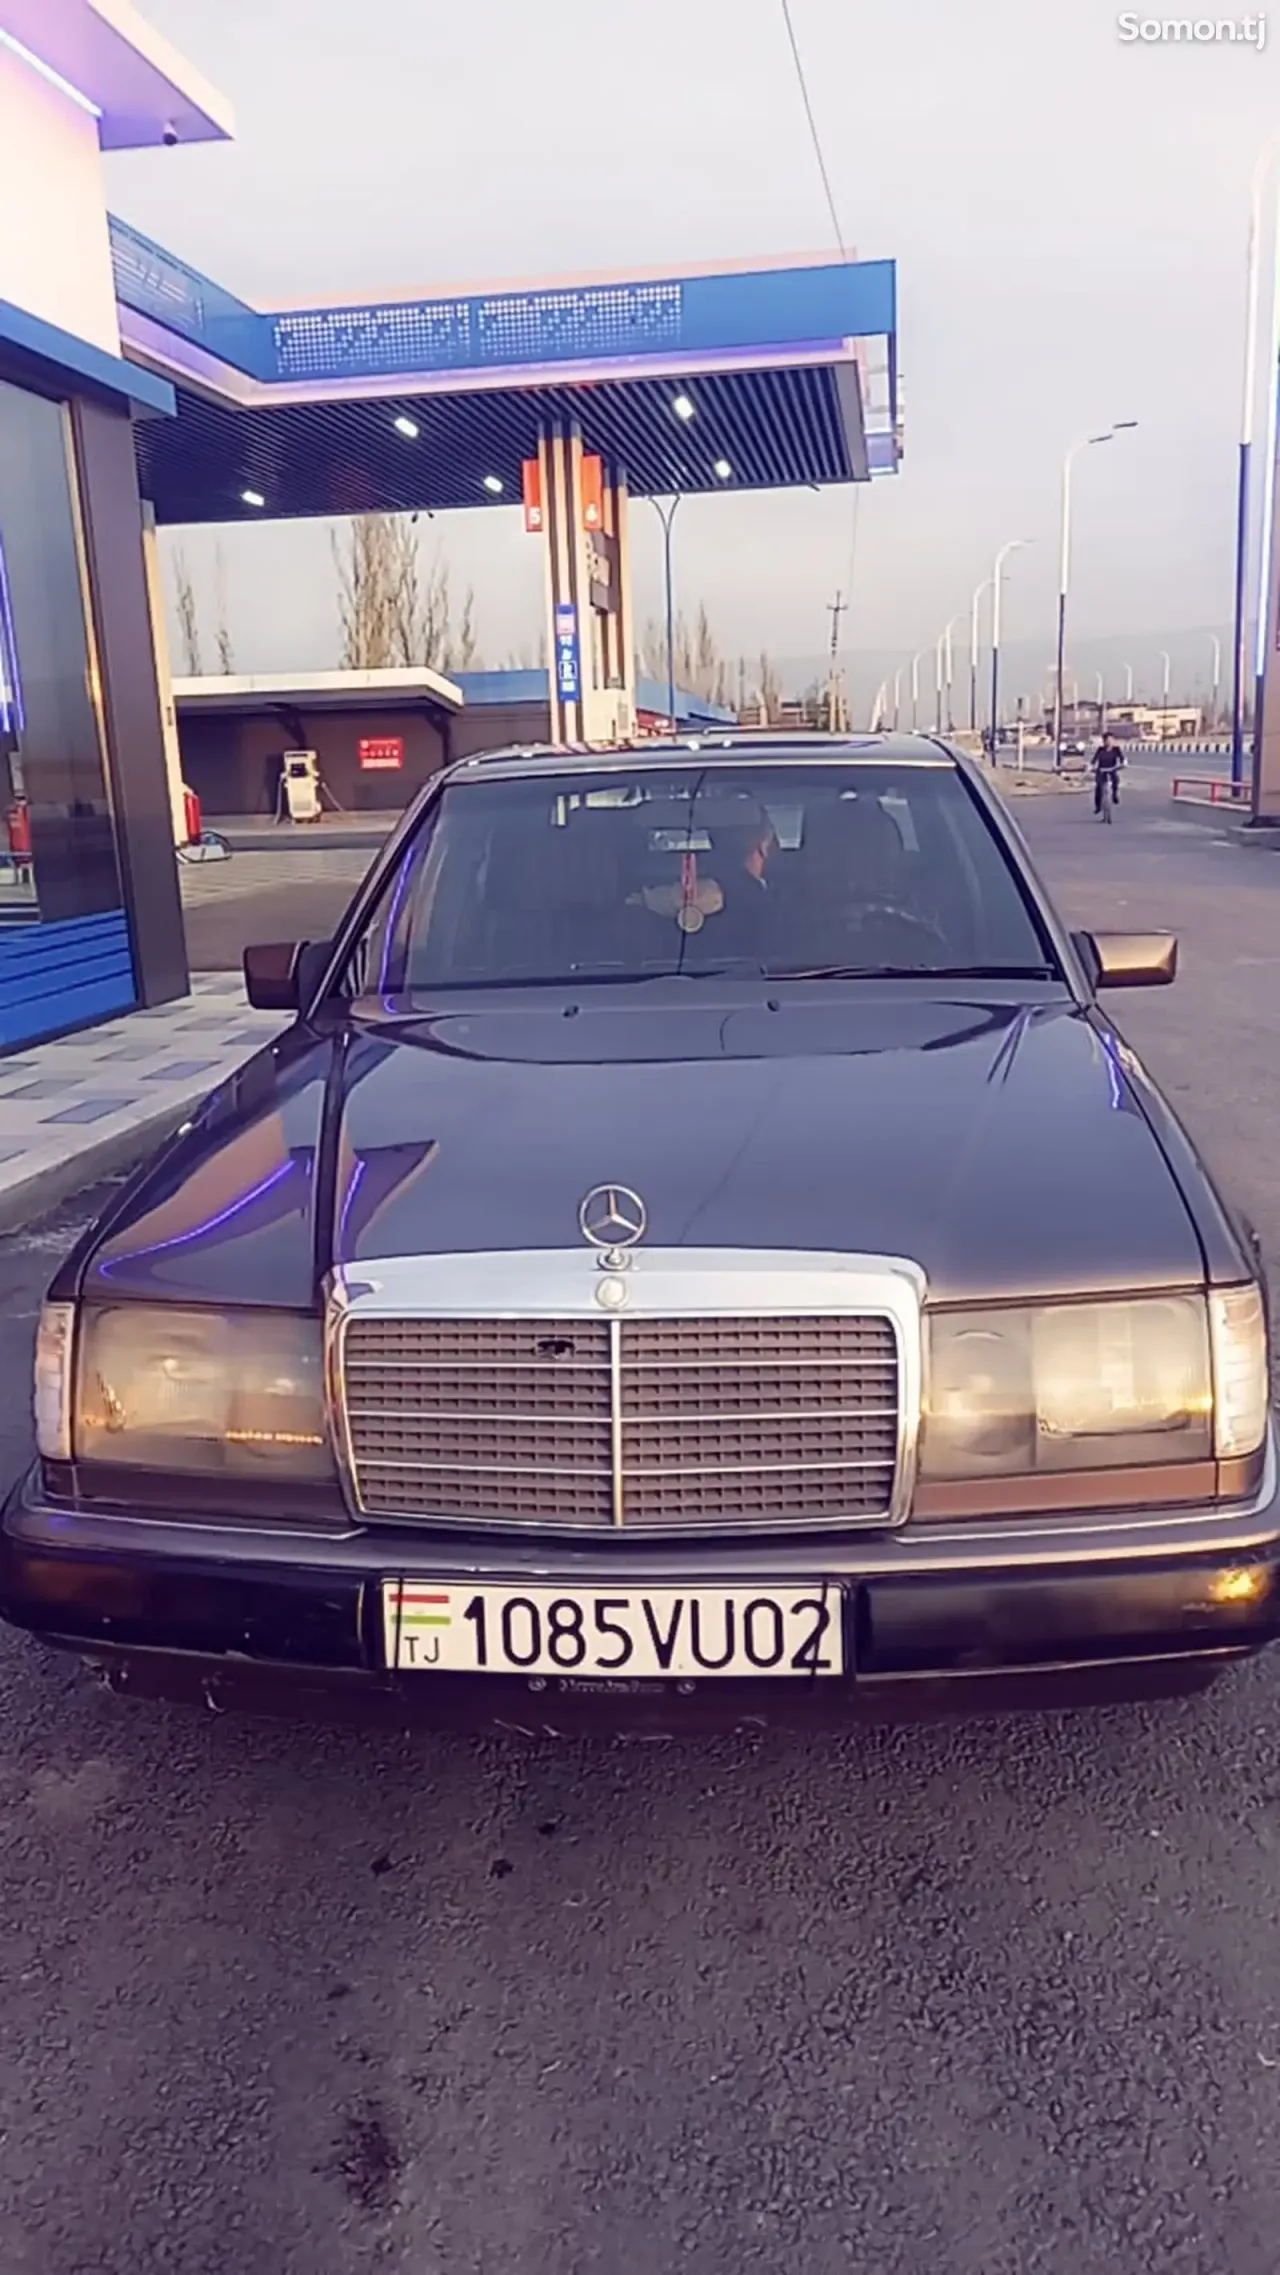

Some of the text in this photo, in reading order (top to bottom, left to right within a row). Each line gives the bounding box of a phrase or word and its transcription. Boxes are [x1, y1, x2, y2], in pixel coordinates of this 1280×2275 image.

[529, 507, 541, 525] 5
[463, 1595, 832, 1670] 1085VU02
[404, 1636, 440, 1664] TJ
